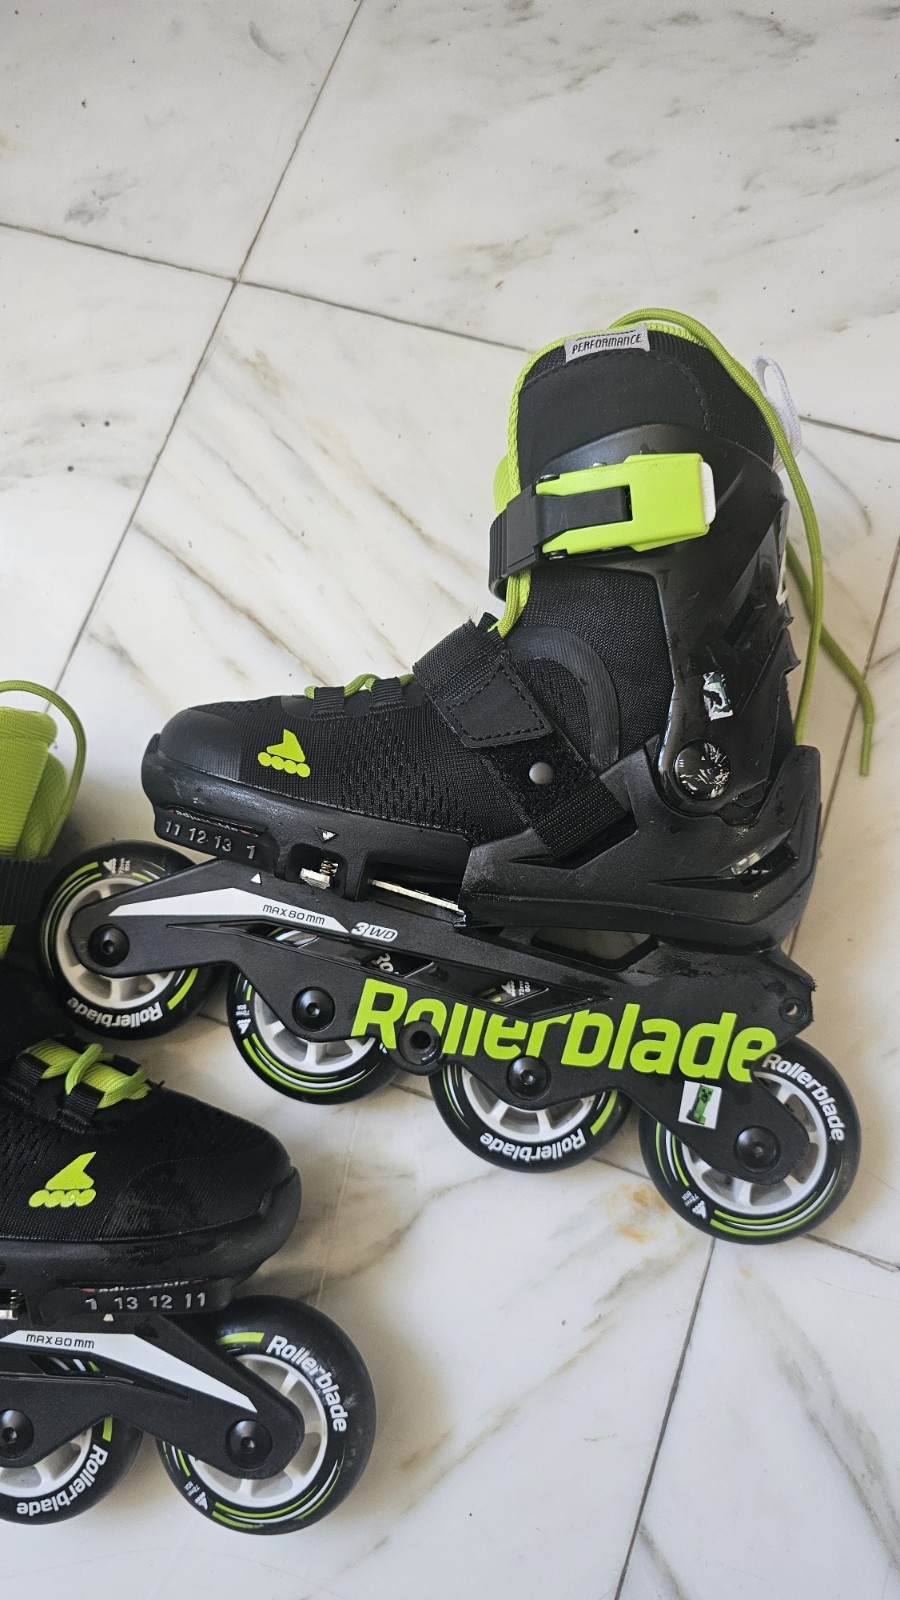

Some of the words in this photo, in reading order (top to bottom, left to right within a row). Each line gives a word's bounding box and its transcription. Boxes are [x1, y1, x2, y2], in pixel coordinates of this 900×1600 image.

[571, 333, 643, 354] PERFORMANCE
[165, 820, 181, 836] 11
[189, 827, 207, 844] 12
[214, 835, 232, 852] 13
[246, 845, 256, 860] 1
[262, 904, 289, 917] MAX
[288, 911, 306, 921] 80
[351, 922, 399, 943] 3WD
[66, 997, 163, 1029] Rollerblade
[349, 978, 779, 1083] Rollerblade
[763, 1052, 845, 1142] Rollerblade
[480, 1127, 587, 1162] Rollerblade
[85, 1298, 98, 1310] 1
[114, 1296, 139, 1310] 13
[149, 1294, 173, 1309] 12
[185, 1292, 206, 1309] 11
[26, 1334, 53, 1345] MAX
[54, 1337, 73, 1346] 80
[266, 1335, 347, 1432] Rollerblade
[16, 1444, 109, 1516] Rollerblade
